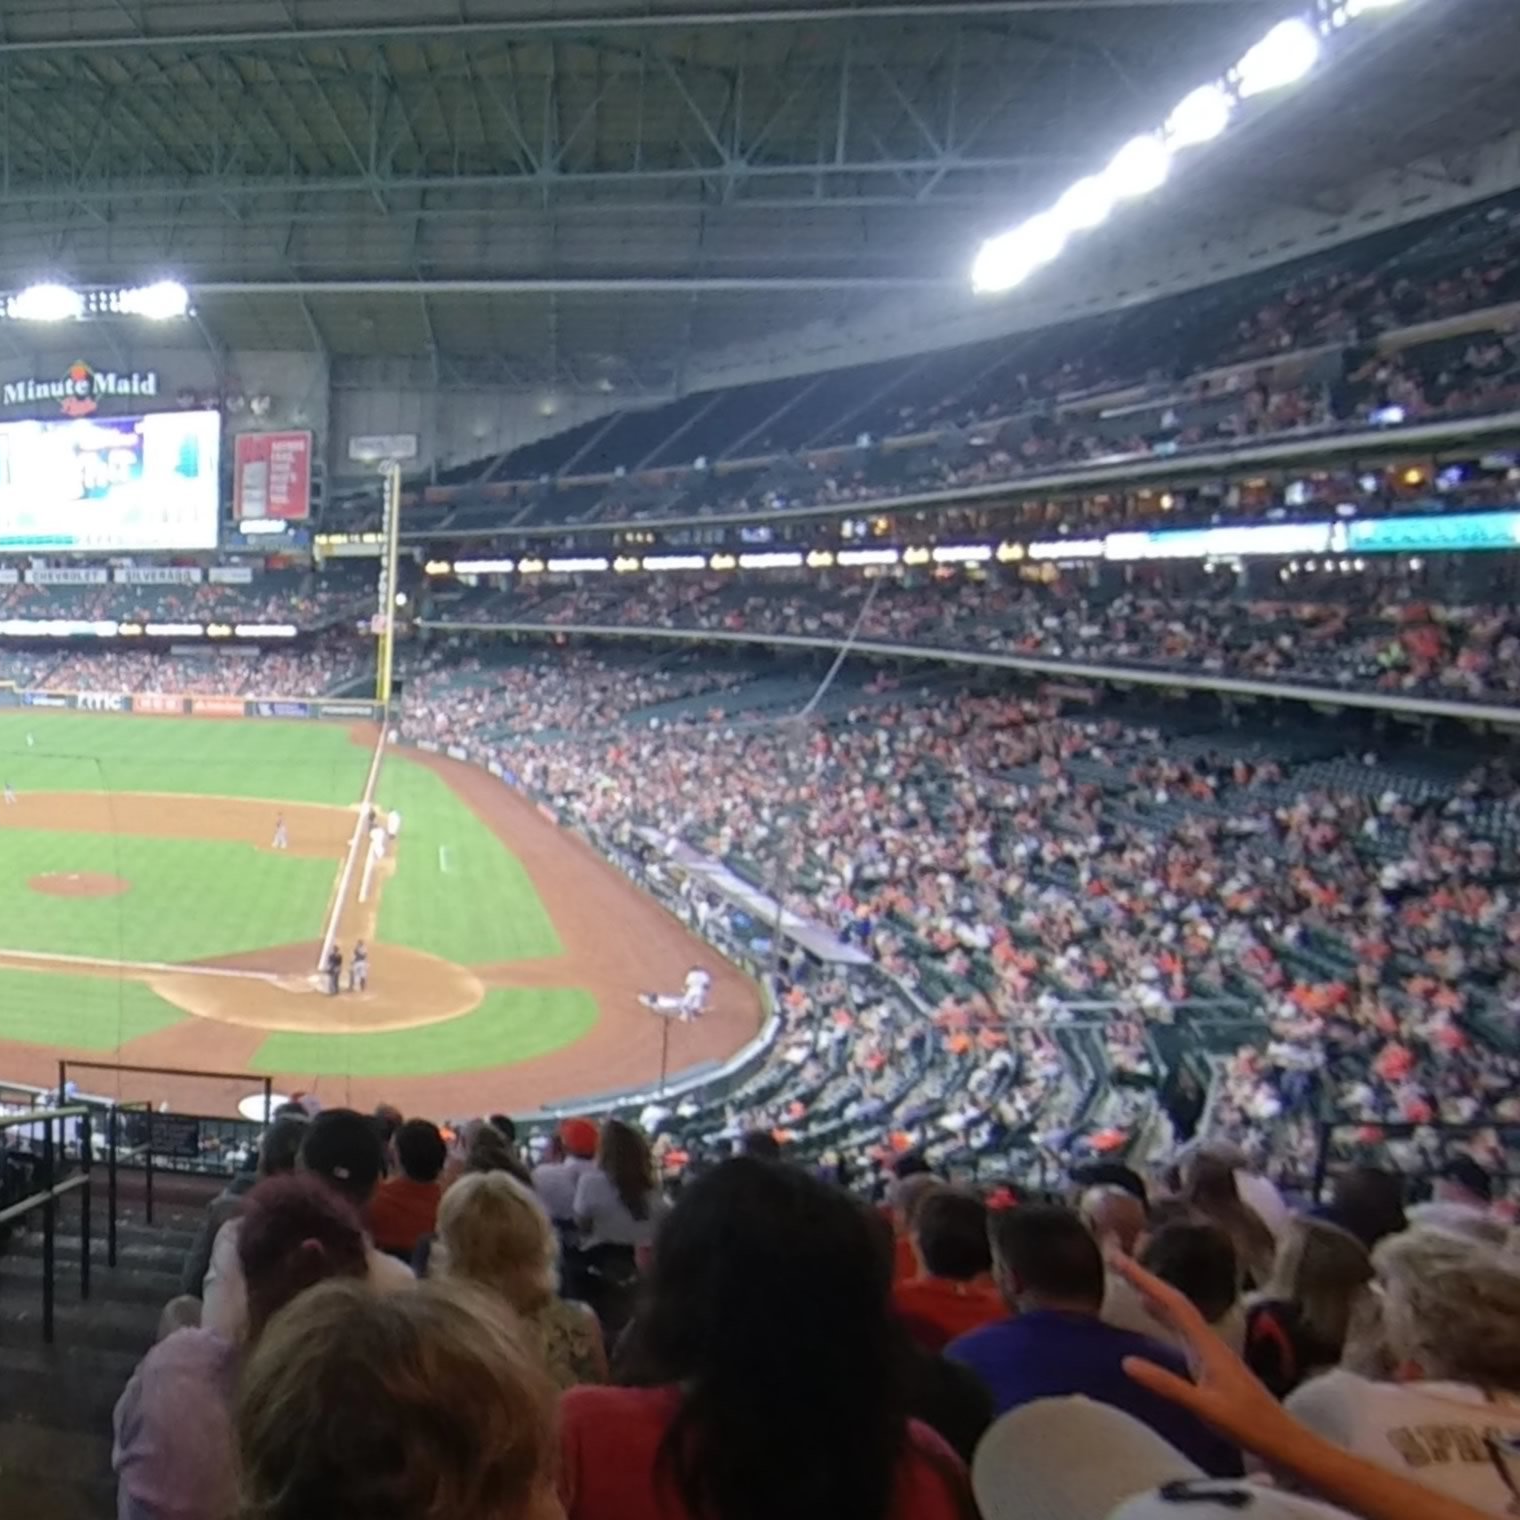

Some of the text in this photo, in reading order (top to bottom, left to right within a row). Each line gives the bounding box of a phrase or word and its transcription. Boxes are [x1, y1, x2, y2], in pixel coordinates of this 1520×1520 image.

[3, 372, 157, 404] Minute Maid
[32, 571, 192, 583] CHEVROLET SILVERADO
